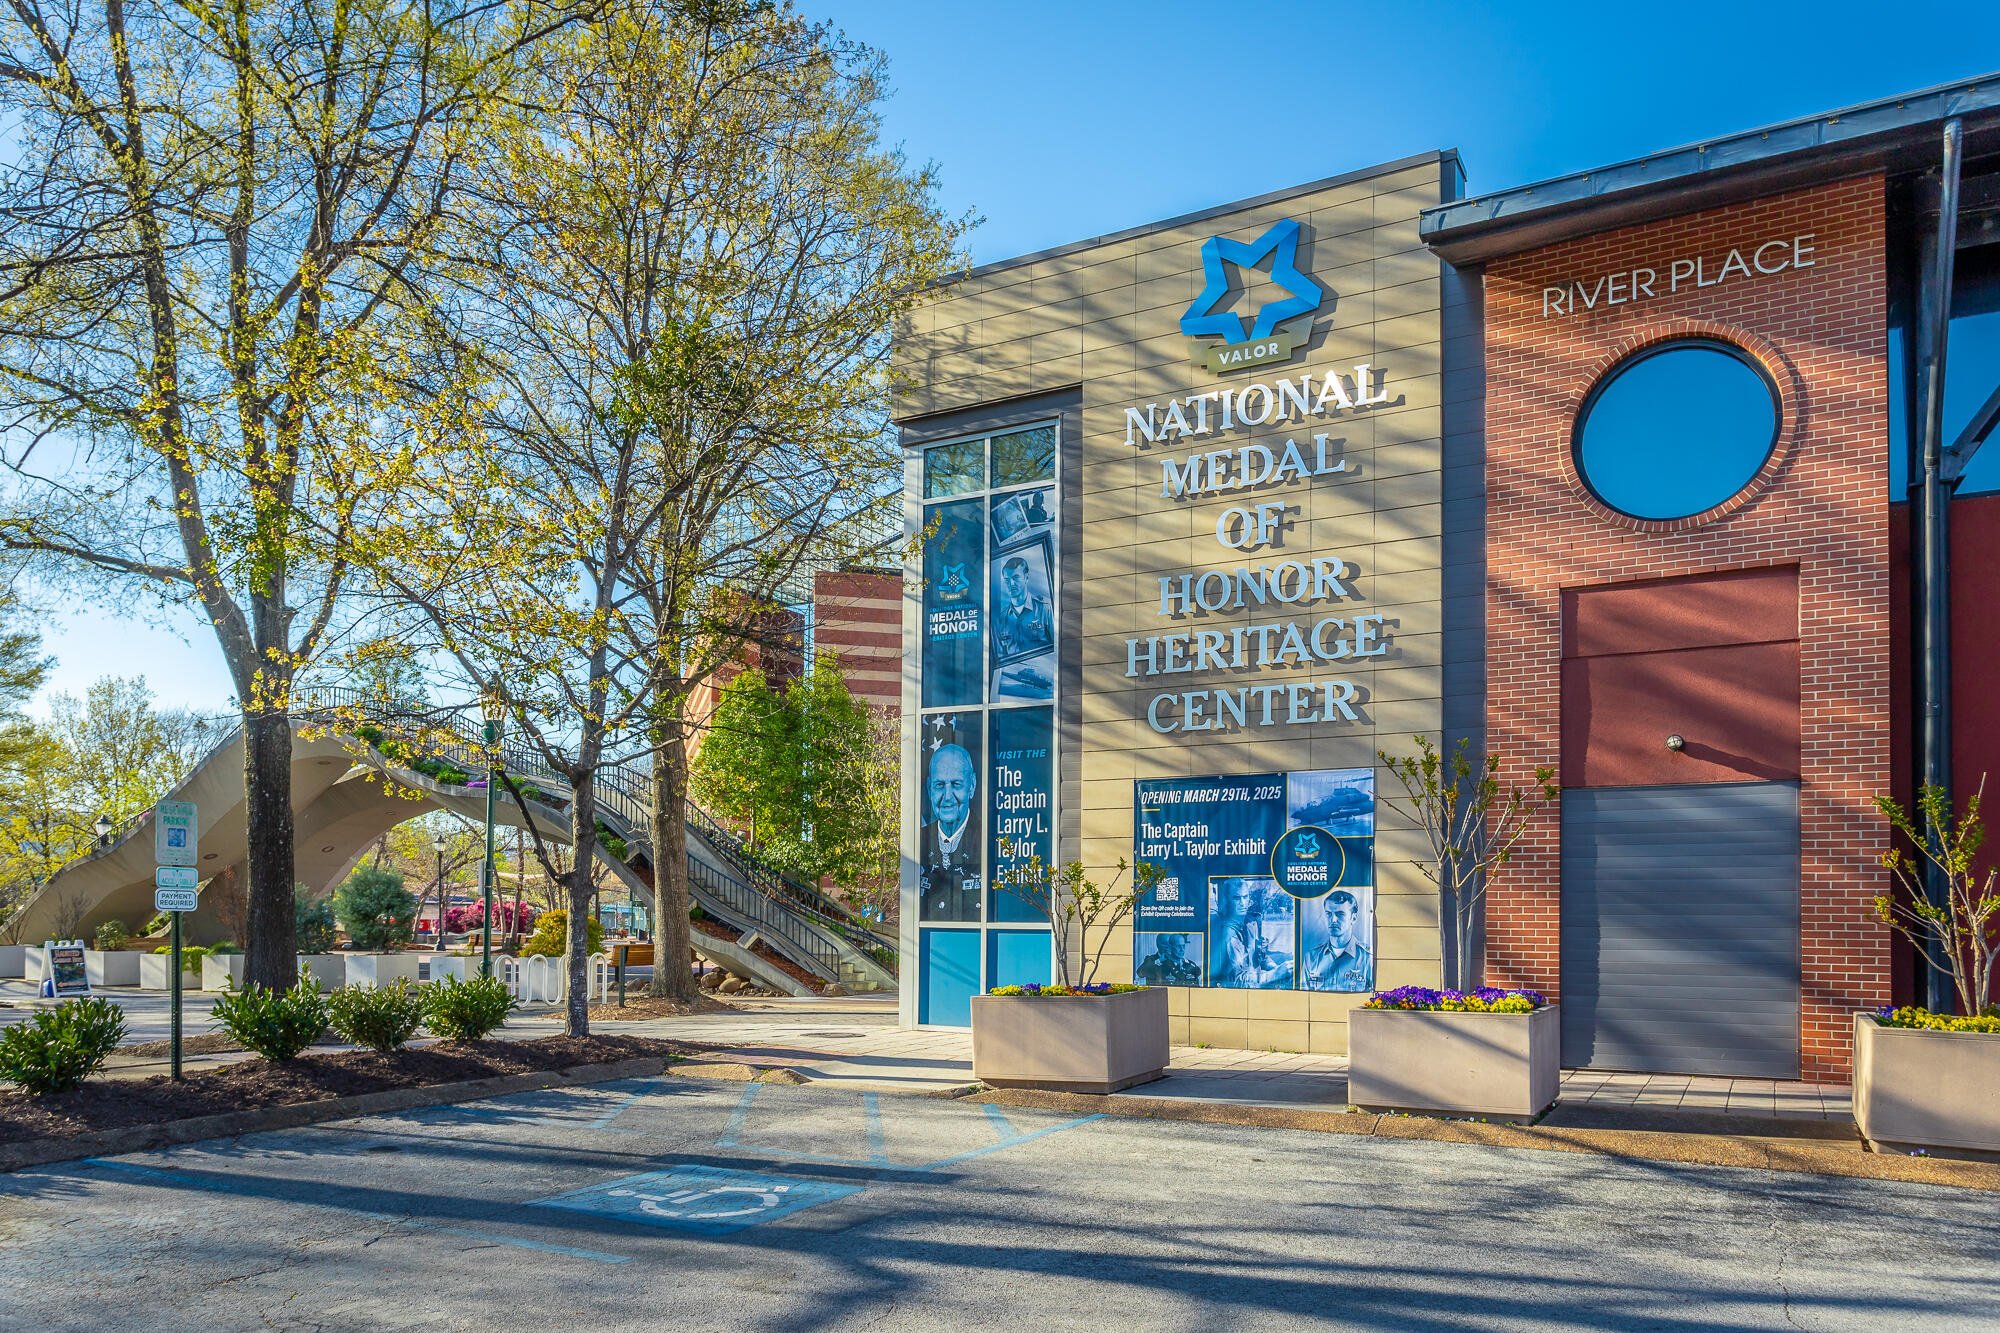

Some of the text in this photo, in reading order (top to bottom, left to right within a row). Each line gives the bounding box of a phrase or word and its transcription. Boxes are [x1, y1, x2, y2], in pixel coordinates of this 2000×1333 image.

[1543, 233, 1816, 319] RIVER PLACE
[1218, 342, 1280, 365] VALOR
[1124, 363, 1388, 446] NATIONAL
[1159, 433, 1346, 498] MEDAL
[1216, 501, 1286, 549] OF
[1157, 557, 1348, 616] HONOR
[929, 610, 968, 623] MEDAL
[929, 620, 978, 635] HONOR
[1125, 614, 1387, 677] HERITAGE
[1148, 680, 1359, 733] CENTER
[996, 749, 1047, 760] VISIT THE
[995, 766, 1022, 788] The
[995, 788, 1046, 813] Captain
[1141, 786, 1282, 805] OPENING MARCH 29TH, 2025
[996, 813, 1048, 838] Larry L.
[1141, 821, 1209, 841] The Captain
[995, 837, 1037, 862] Taylor
[1140, 838, 1267, 860] Larry L. Taylor Exhibit
[1287, 873, 1328, 882] HONOR
[161, 892, 192, 900] PAYMENT
